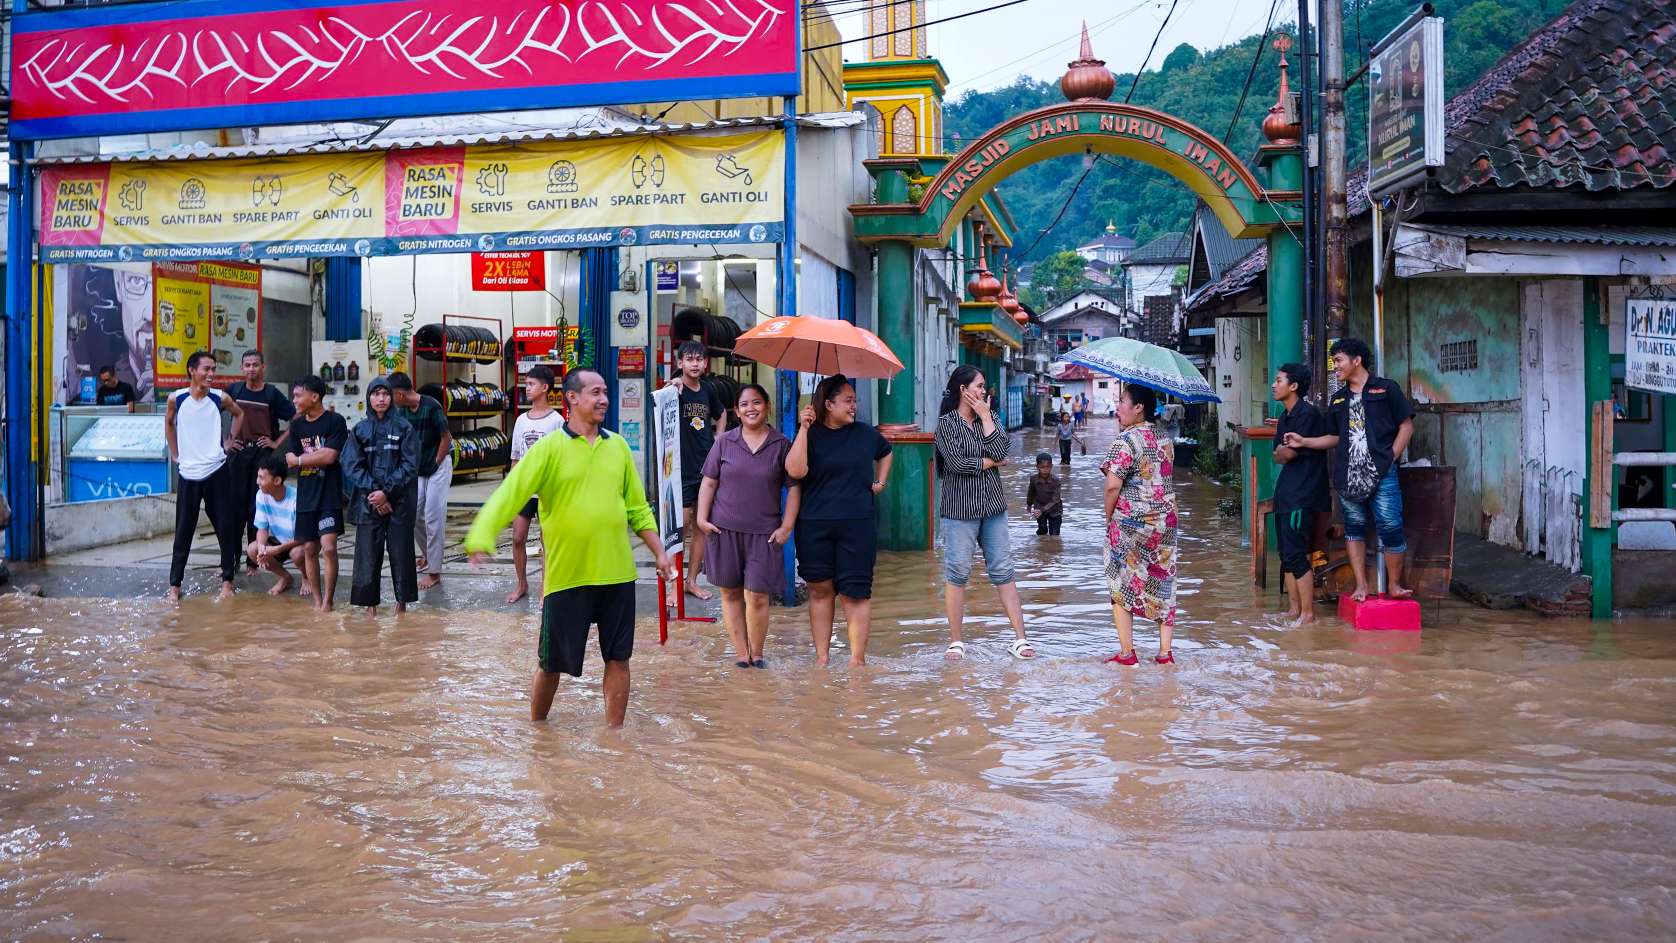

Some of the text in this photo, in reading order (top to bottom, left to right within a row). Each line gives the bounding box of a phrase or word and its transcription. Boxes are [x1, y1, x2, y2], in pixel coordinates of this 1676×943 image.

[941, 113, 1238, 201] MASJID JAMI NURUL IMAN
[407, 167, 446, 182] RASA
[59, 182, 93, 196] RASA
[405, 184, 453, 199] MESIN
[527, 197, 598, 211] GANTI BAN
[610, 193, 686, 207] SPARE PART
[700, 191, 768, 204] GANTI OLI
[56, 198, 99, 212] MESIN
[402, 203, 445, 217] BARU
[471, 201, 513, 214] SERVIS
[161, 214, 222, 225] GANTI BAN
[233, 210, 300, 223] SPARE PART
[312, 208, 372, 220] GANTI OLI
[53, 215, 92, 228] BARU
[113, 216, 150, 226] SERVIS
[506, 232, 612, 246] GRATIS ONGKOS PASANG
[649, 229, 741, 240] GRATIS PENGECEKAN
[266, 243, 347, 254] GRATIS PENGECEKAN
[399, 239, 472, 250] GRATIS NITROGEN
[50, 249, 113, 258] GRATIS NITROGEN
[143, 247, 233, 257] GRATIS ONGKOS PASANG
[483, 261, 505, 277] 2X
[506, 260, 531, 269] LEBIH
[200, 263, 217, 277] RASA
[218, 267, 239, 280] MESIN
[240, 270, 258, 283] BARU
[506, 269, 529, 277] LAMA
[482, 276, 529, 285] Dari Oli Biasa
[621, 311, 639, 319] TOP
[516, 330, 540, 338] SERVIS
[1637, 340, 1676, 357] PRAKTEK
[88, 477, 152, 497] vivo
